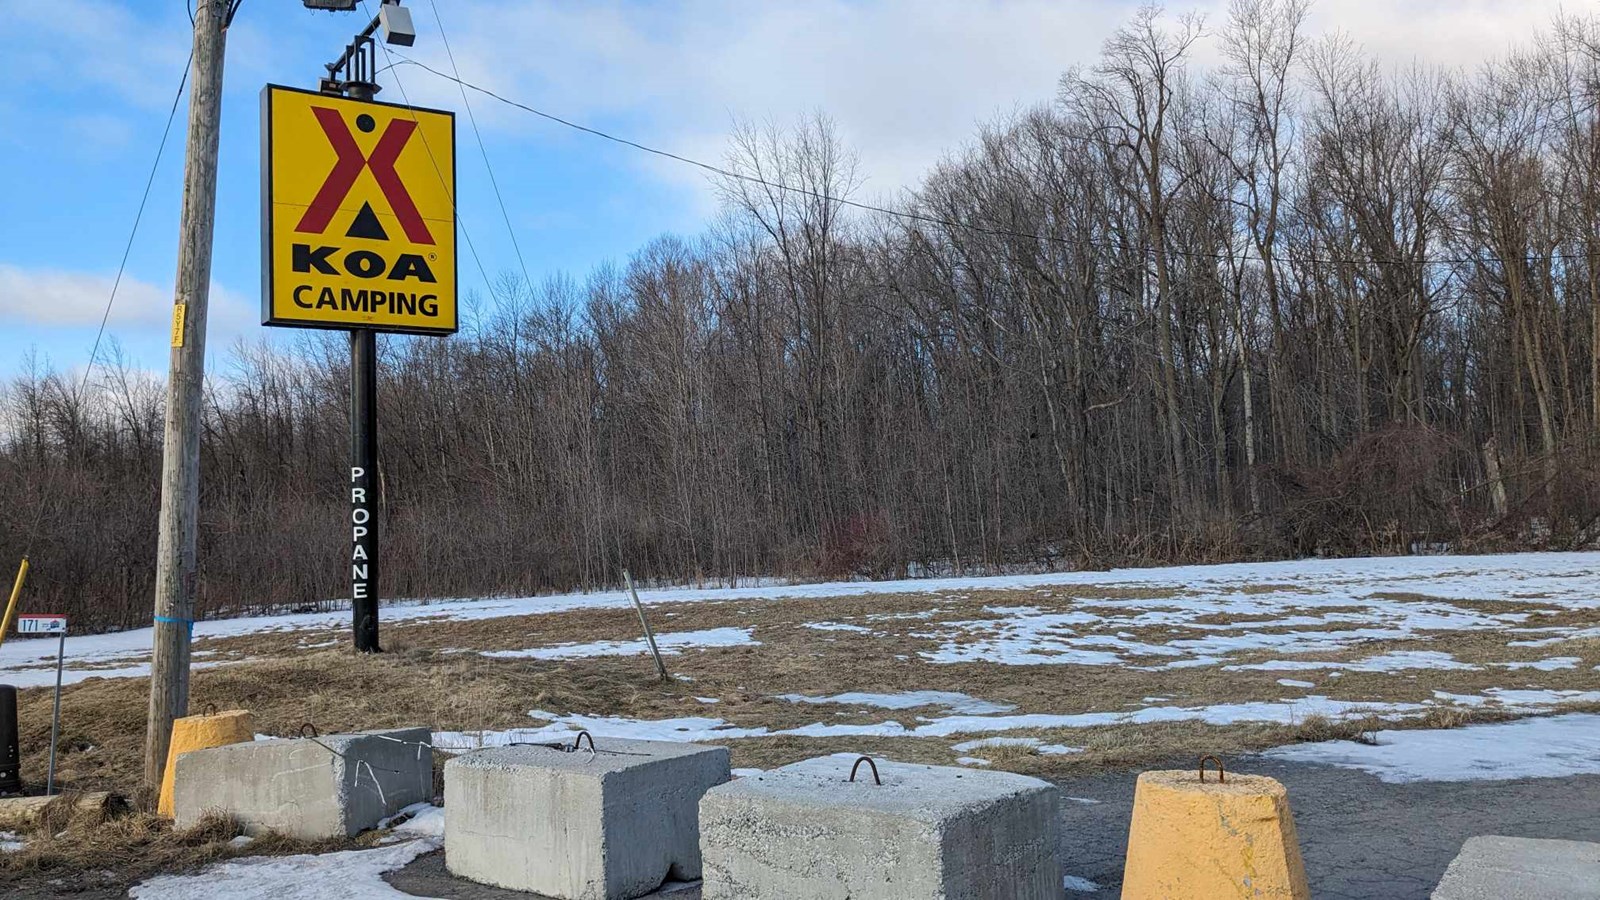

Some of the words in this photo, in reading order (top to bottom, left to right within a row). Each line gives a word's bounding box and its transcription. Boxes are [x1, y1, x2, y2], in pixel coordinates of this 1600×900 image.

[292, 243, 437, 283] KOA
[293, 285, 438, 317] CAMPING
[351, 467, 370, 599] PROPANE
[23, 619, 38, 631] 171
